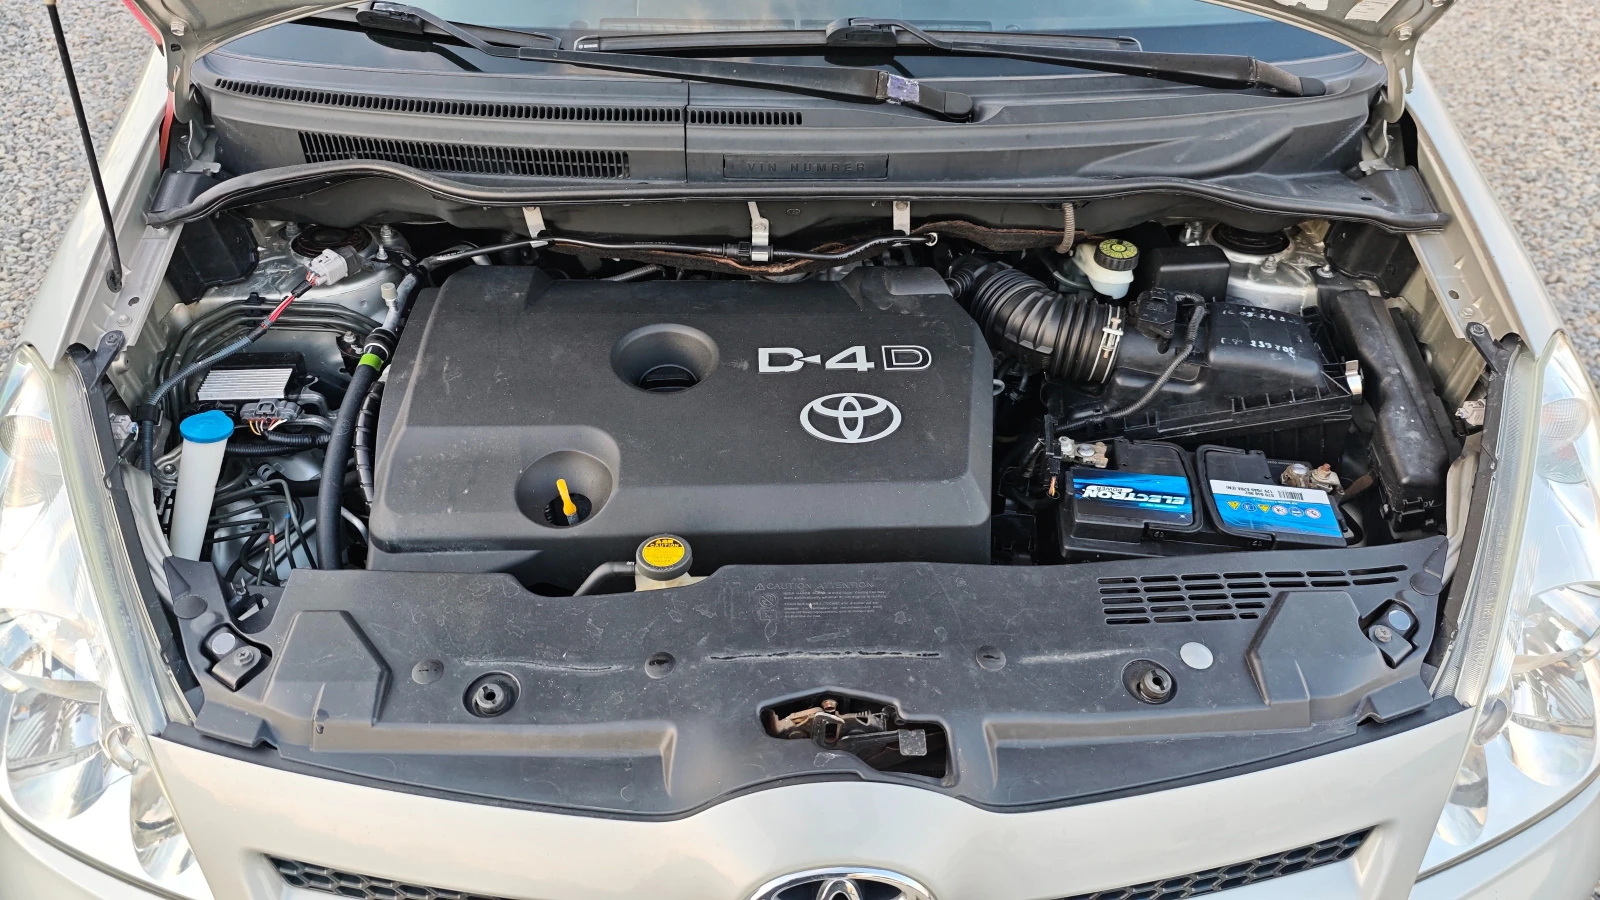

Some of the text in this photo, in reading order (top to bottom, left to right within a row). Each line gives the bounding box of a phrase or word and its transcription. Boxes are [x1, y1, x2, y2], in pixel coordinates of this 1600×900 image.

[747, 162, 866, 172] VIN NUMBER
[1082, 488, 1186, 505] ELECTRON
[766, 581, 875, 590] CAUTION ATTENTION
